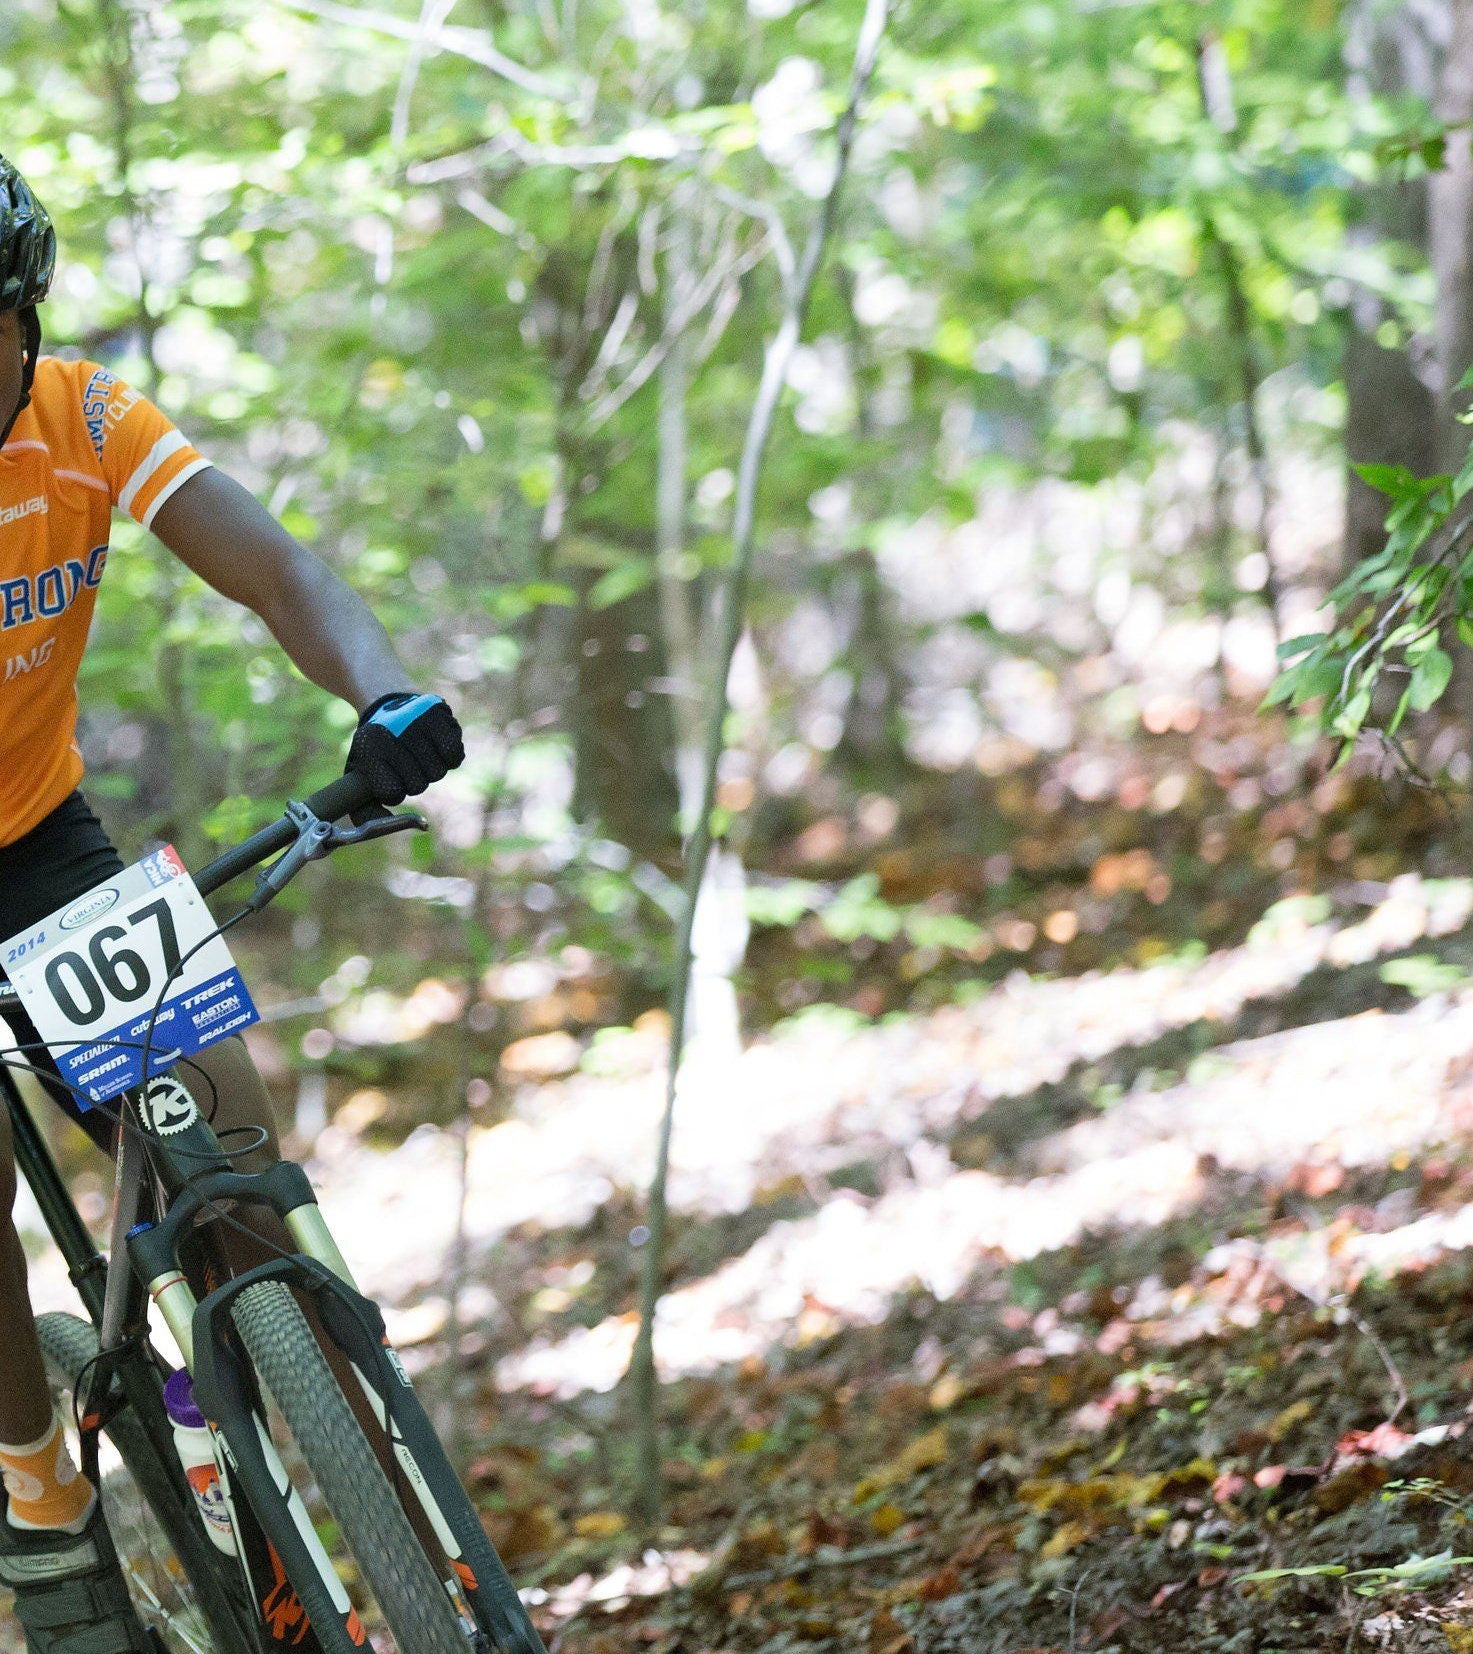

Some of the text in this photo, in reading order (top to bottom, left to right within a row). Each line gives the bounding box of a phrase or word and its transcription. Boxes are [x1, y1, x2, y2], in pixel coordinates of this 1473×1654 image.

[67, 895, 112, 923] VIRGINIA
[8, 931, 46, 962] 2014
[44, 897, 184, 1026] 067
[180, 976, 235, 1010] TREK
[192, 995, 240, 1024] EASTON
